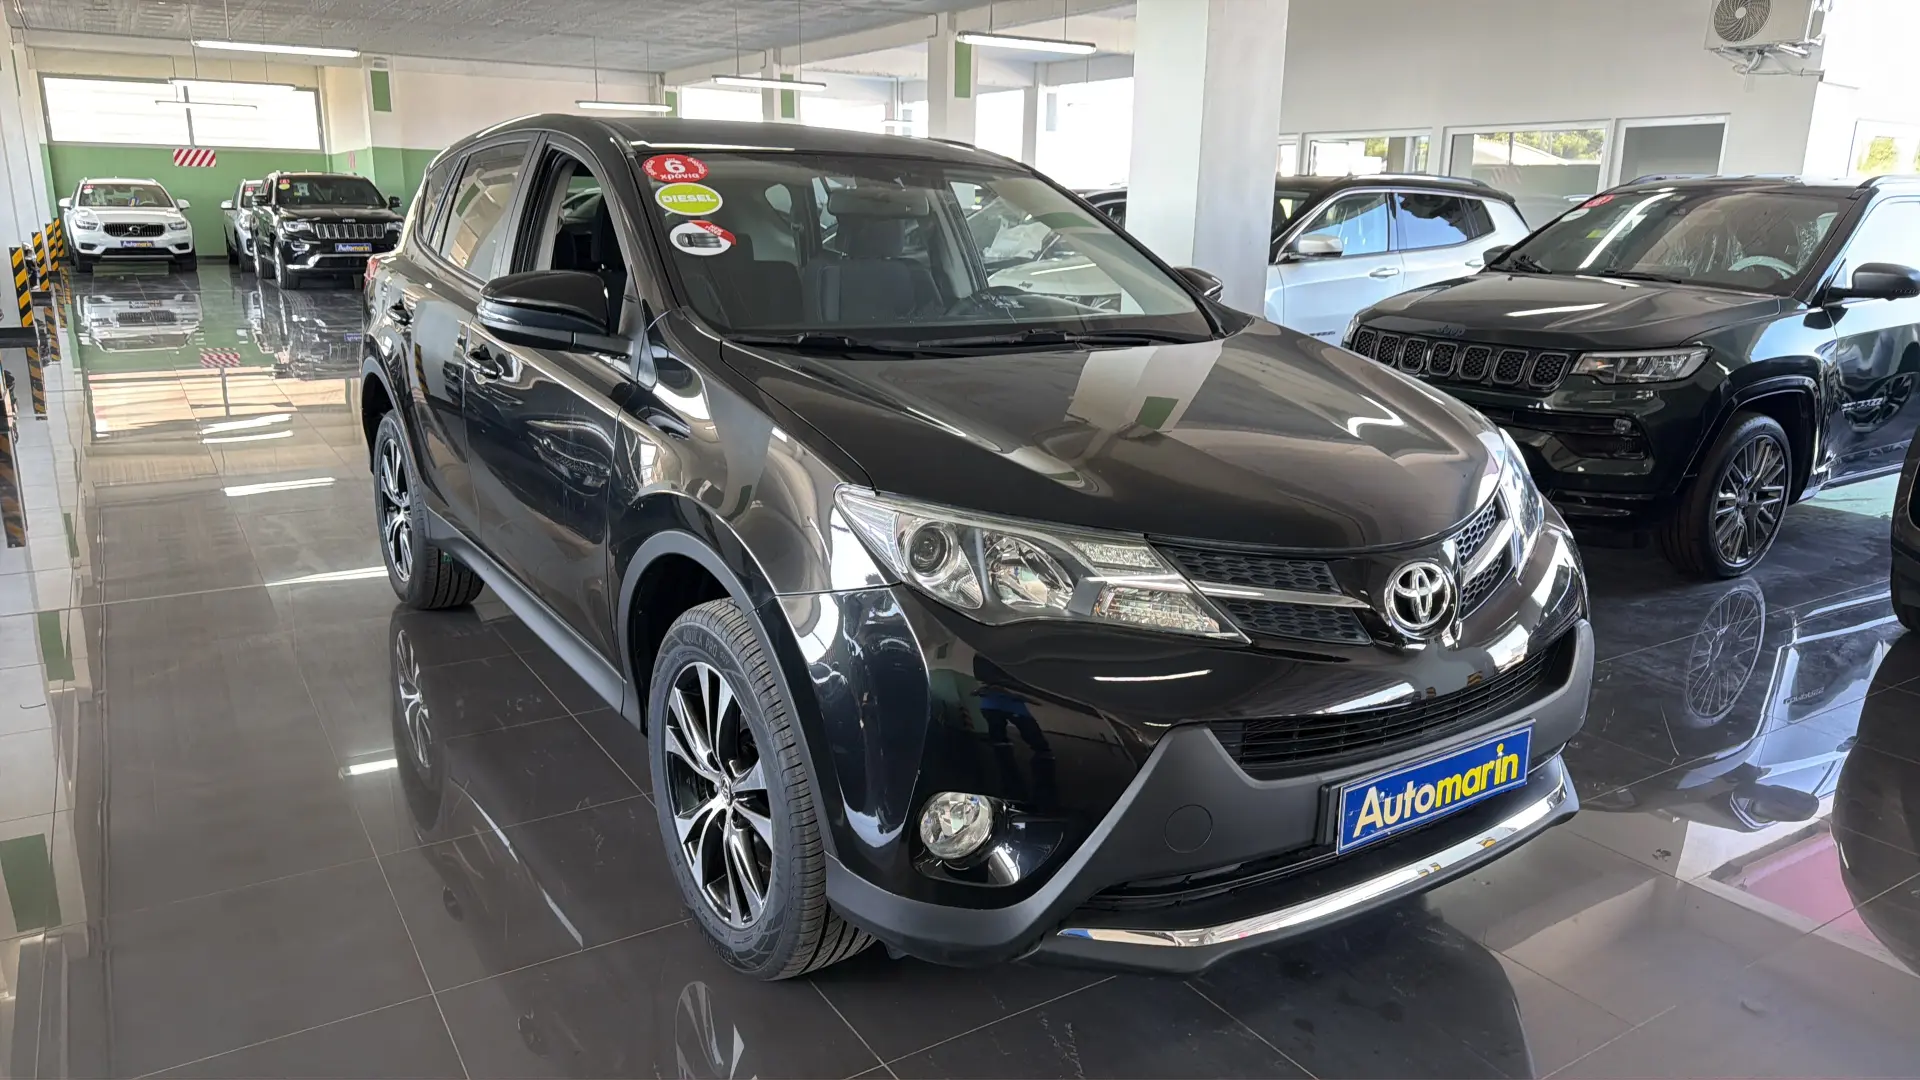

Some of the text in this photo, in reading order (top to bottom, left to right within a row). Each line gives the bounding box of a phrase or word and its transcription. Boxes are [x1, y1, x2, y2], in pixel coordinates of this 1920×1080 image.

[664, 160, 686, 174] 6
[661, 194, 717, 203] DIESEL
[1352, 742, 1520, 838] Automarin
